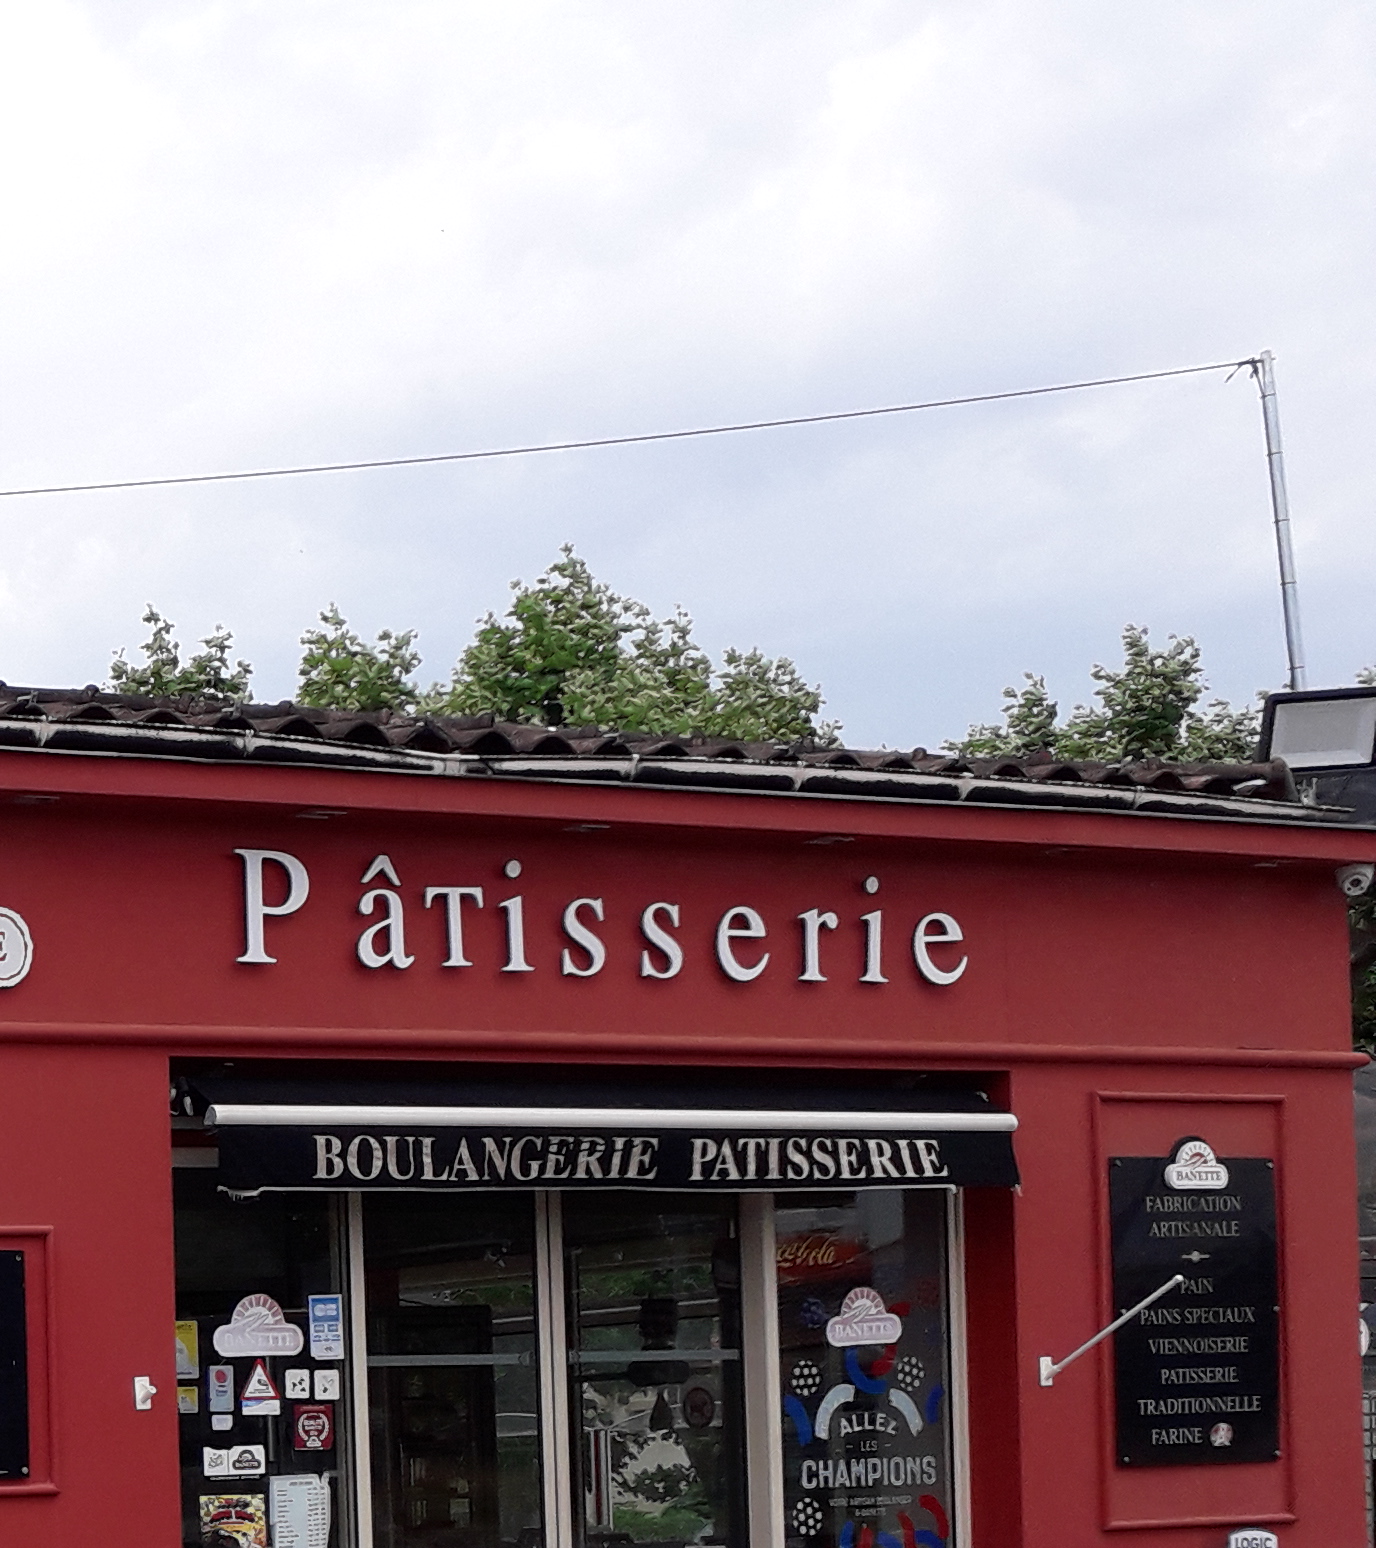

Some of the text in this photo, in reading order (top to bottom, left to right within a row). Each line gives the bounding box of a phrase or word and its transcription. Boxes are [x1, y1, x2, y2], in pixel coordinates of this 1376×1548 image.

[312, 1134, 948, 1182] BOULANGERIE PATISSERIE
[1175, 1170, 1222, 1182] BANETTE
[1146, 1196, 1241, 1213] FABRICATION
[1149, 1220, 1240, 1237] ARTISANALE
[1180, 1277, 1214, 1294] PAIN
[1140, 1306, 1256, 1325] PAINS SPECIAUX
[1148, 1336, 1248, 1355] VIENNOISERIE
[1161, 1366, 1239, 1385] PATISSERIE
[1137, 1395, 1261, 1415] TRADITIONNELLE
[840, 1412, 898, 1438] ALLEZ
[1151, 1427, 1203, 1445] FARINE
[860, 1440, 878, 1452] LES
[801, 1455, 937, 1490] CHAMPIONS
